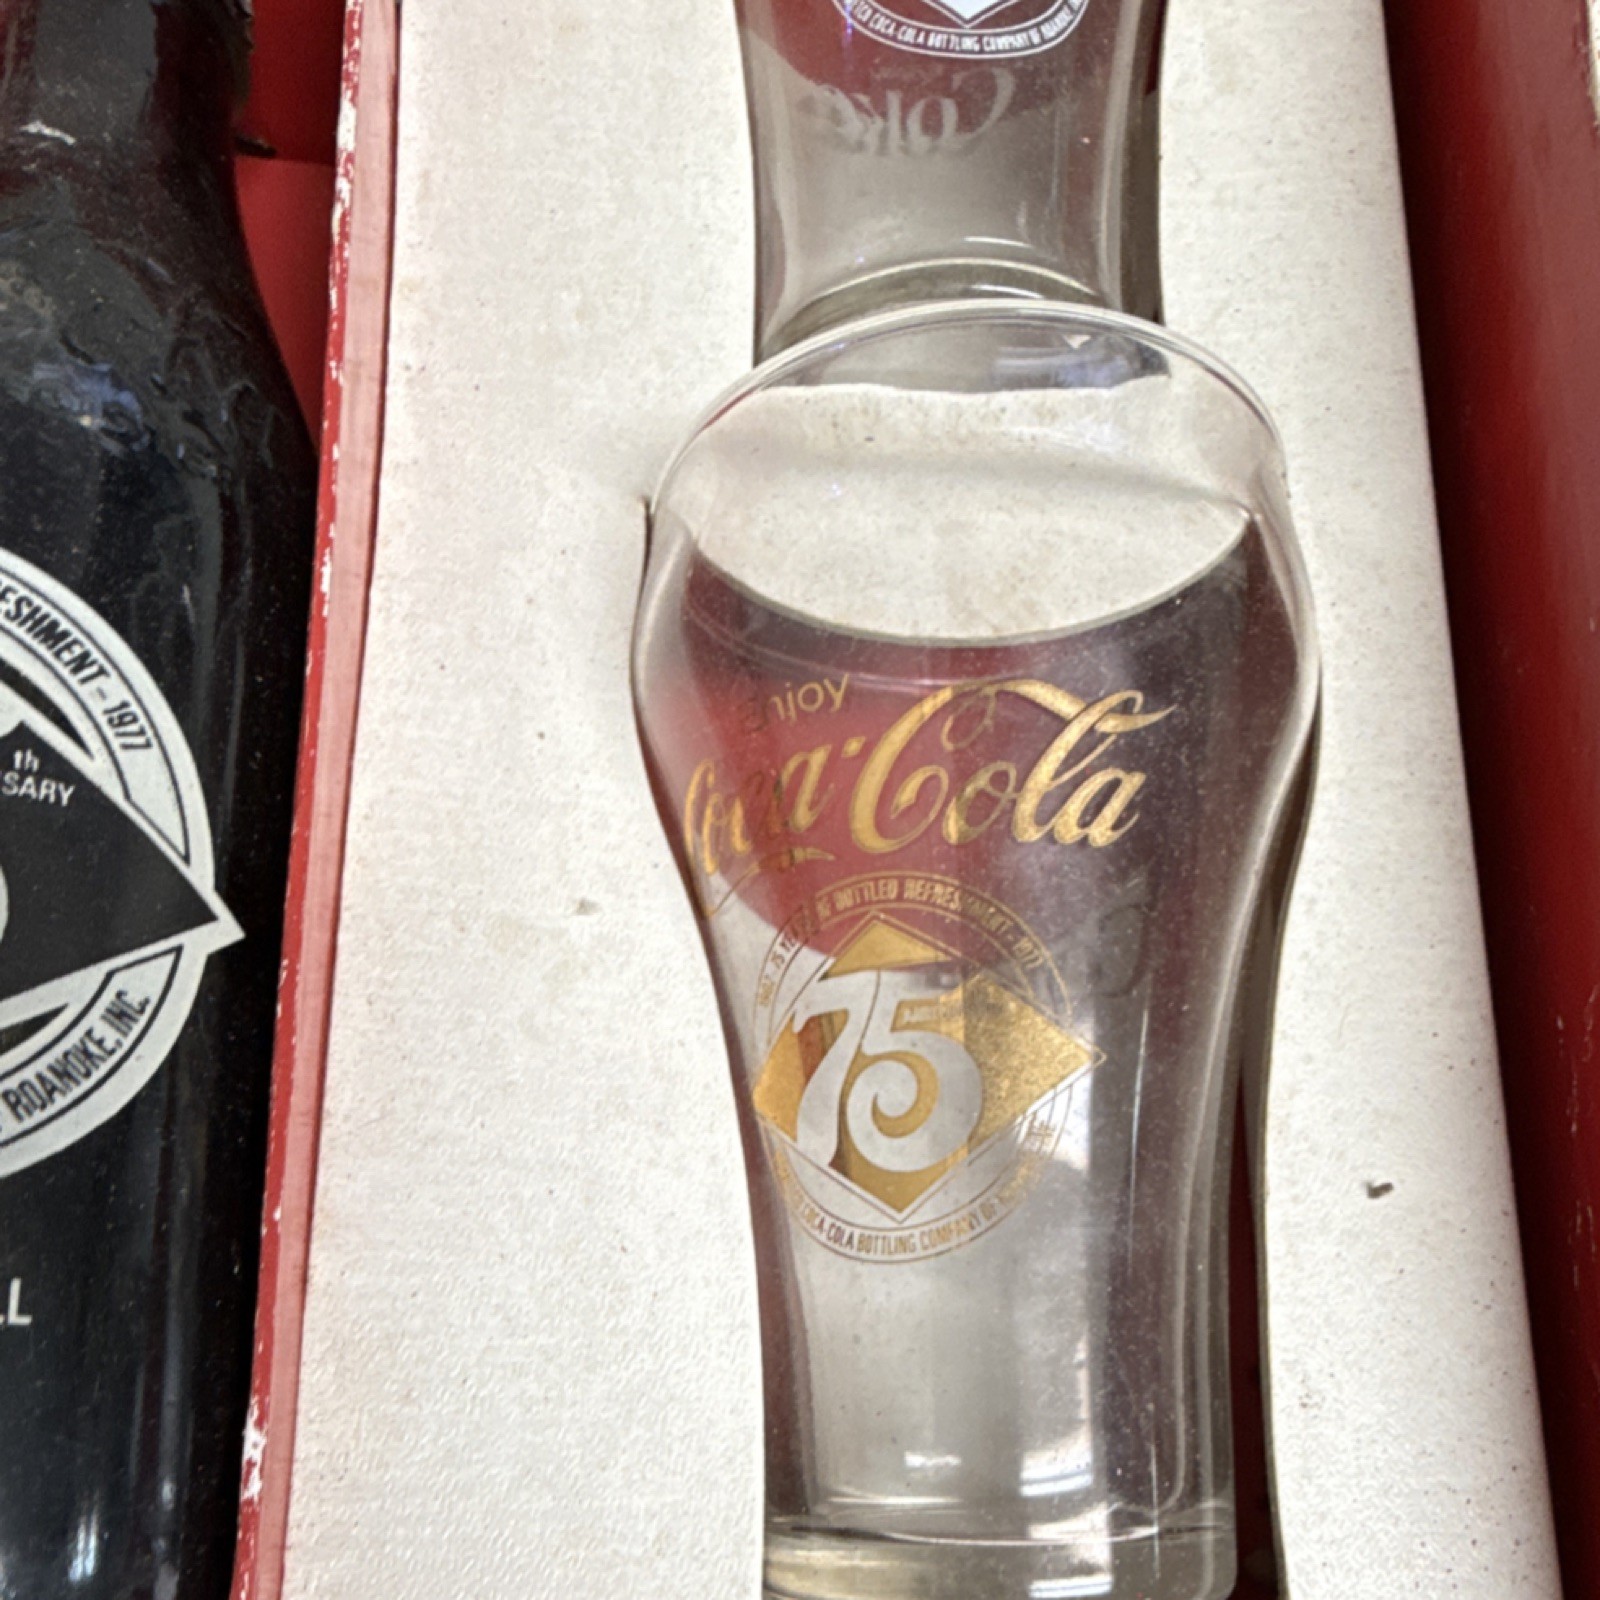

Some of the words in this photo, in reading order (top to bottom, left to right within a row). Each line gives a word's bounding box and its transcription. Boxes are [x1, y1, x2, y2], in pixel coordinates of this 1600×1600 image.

[102, 700, 154, 750] 1977
[14, 751, 40, 770] th
[2, 772, 76, 807] SARY
[792, 968, 984, 1174] 75
[856, 1231, 917, 1257] BOTTLING
[0, 1276, 33, 1327] L
